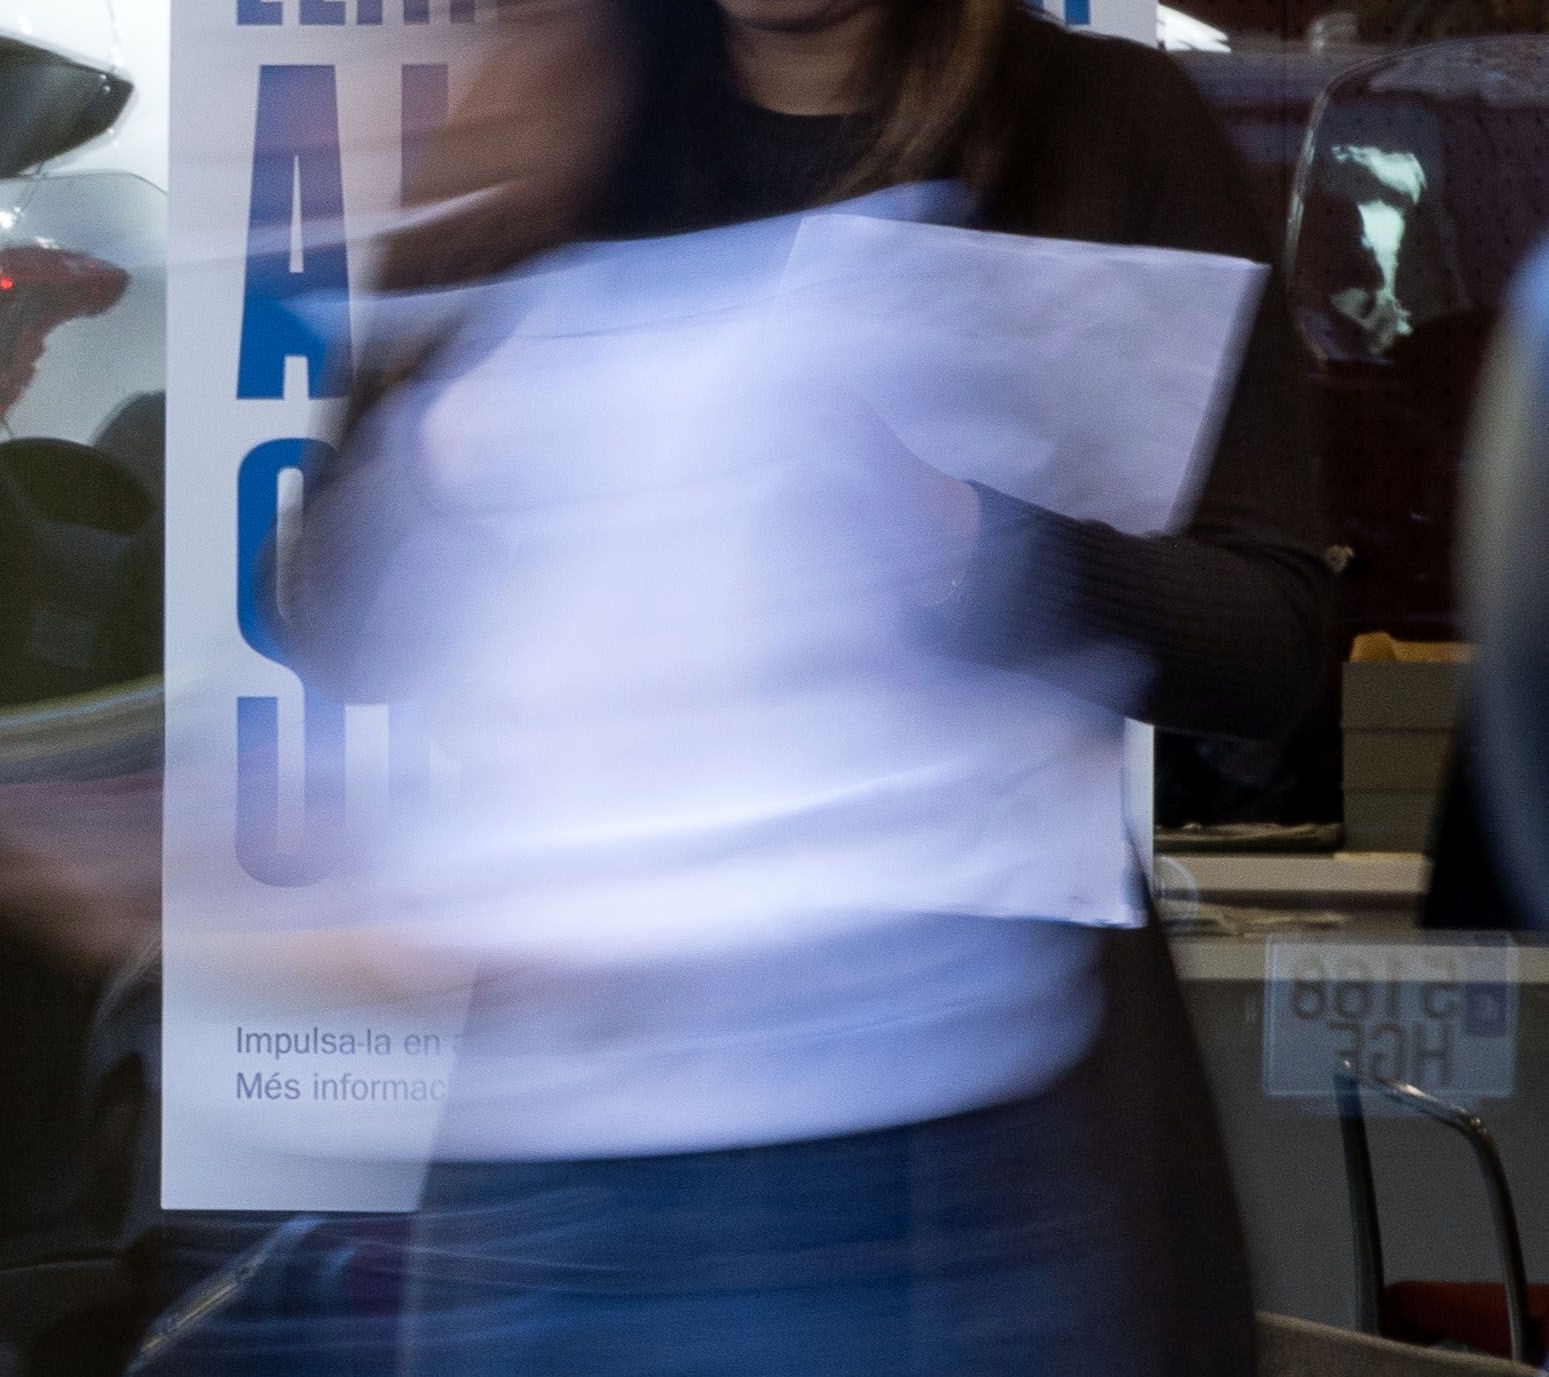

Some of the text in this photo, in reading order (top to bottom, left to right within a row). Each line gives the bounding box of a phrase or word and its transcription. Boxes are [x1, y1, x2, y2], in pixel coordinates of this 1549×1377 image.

[235, 1026, 392, 1060] Impulsa-la
[402, 1033, 441, 1055] en
[235, 1071, 448, 1101] Més informac
